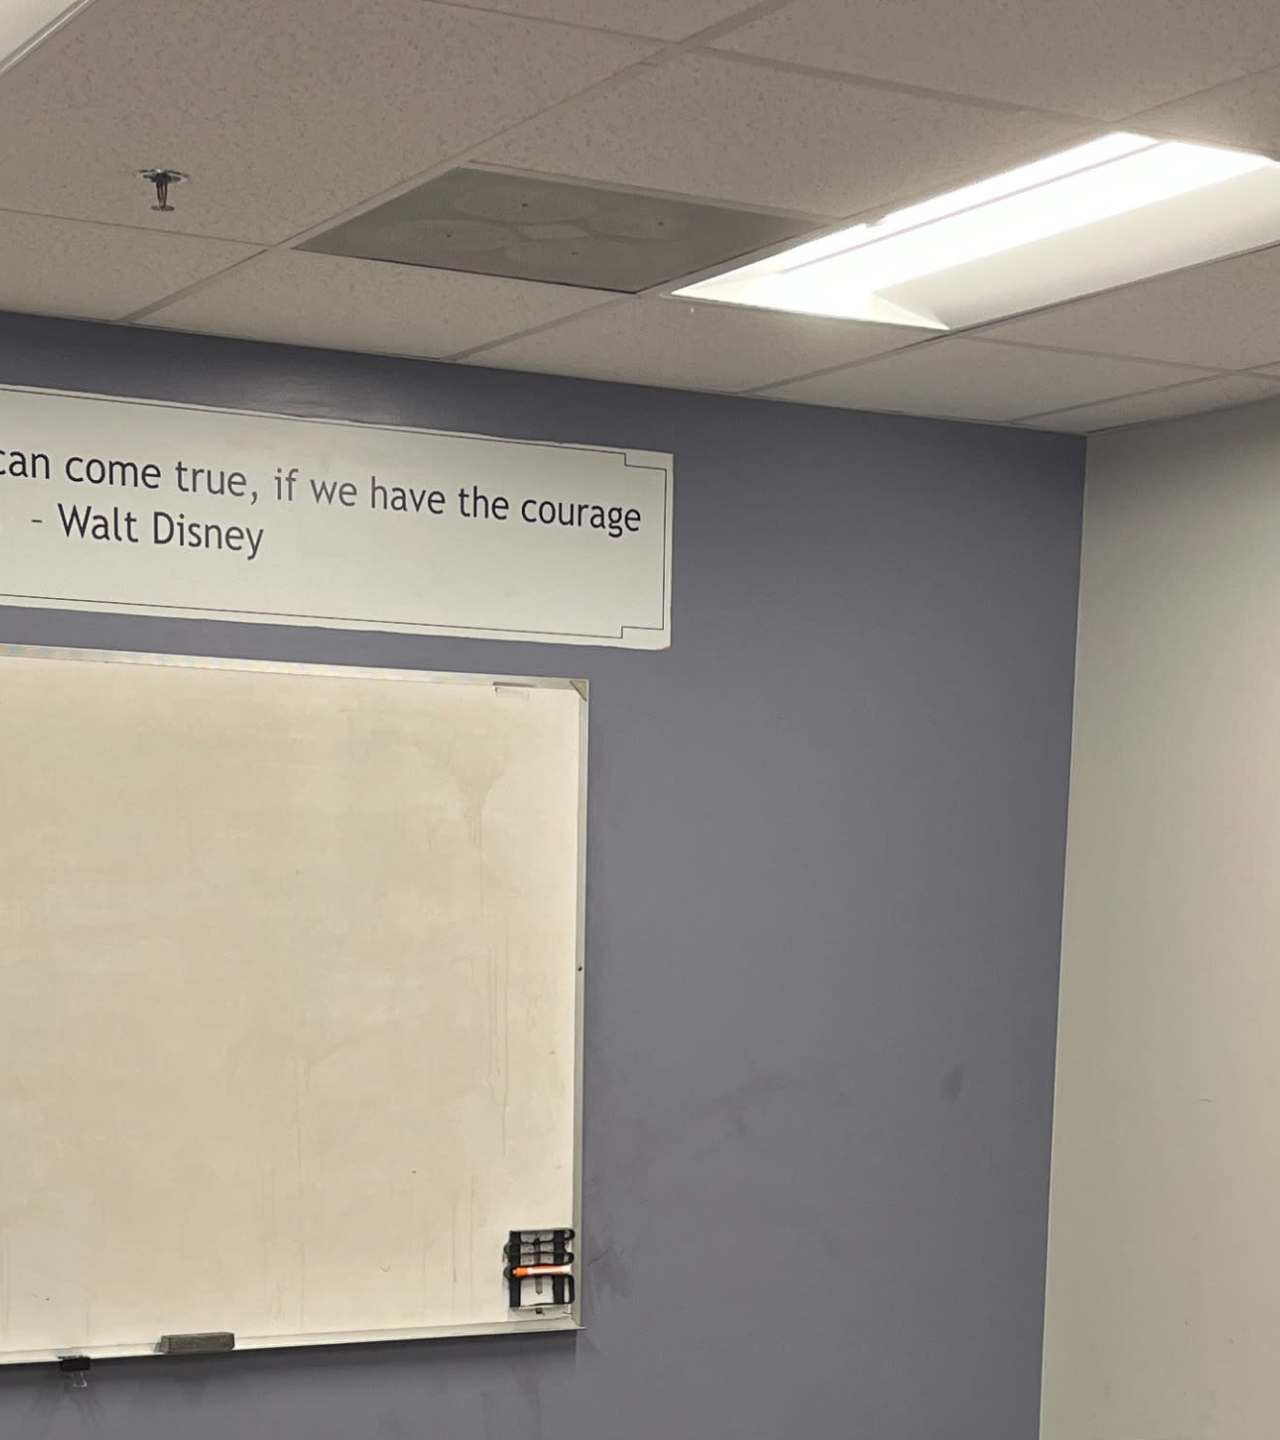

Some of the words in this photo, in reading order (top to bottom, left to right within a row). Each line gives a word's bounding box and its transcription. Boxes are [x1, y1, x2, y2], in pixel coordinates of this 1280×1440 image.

[56, 502, 139, 544] Walt
[153, 510, 265, 561] Disney
[64, 456, 162, 490] come
[174, 460, 258, 506] true,
[274, 468, 299, 502] if
[309, 479, 358, 507] we
[370, 475, 447, 515] have
[457, 485, 510, 521] the
[521, 498, 642, 539] courage
